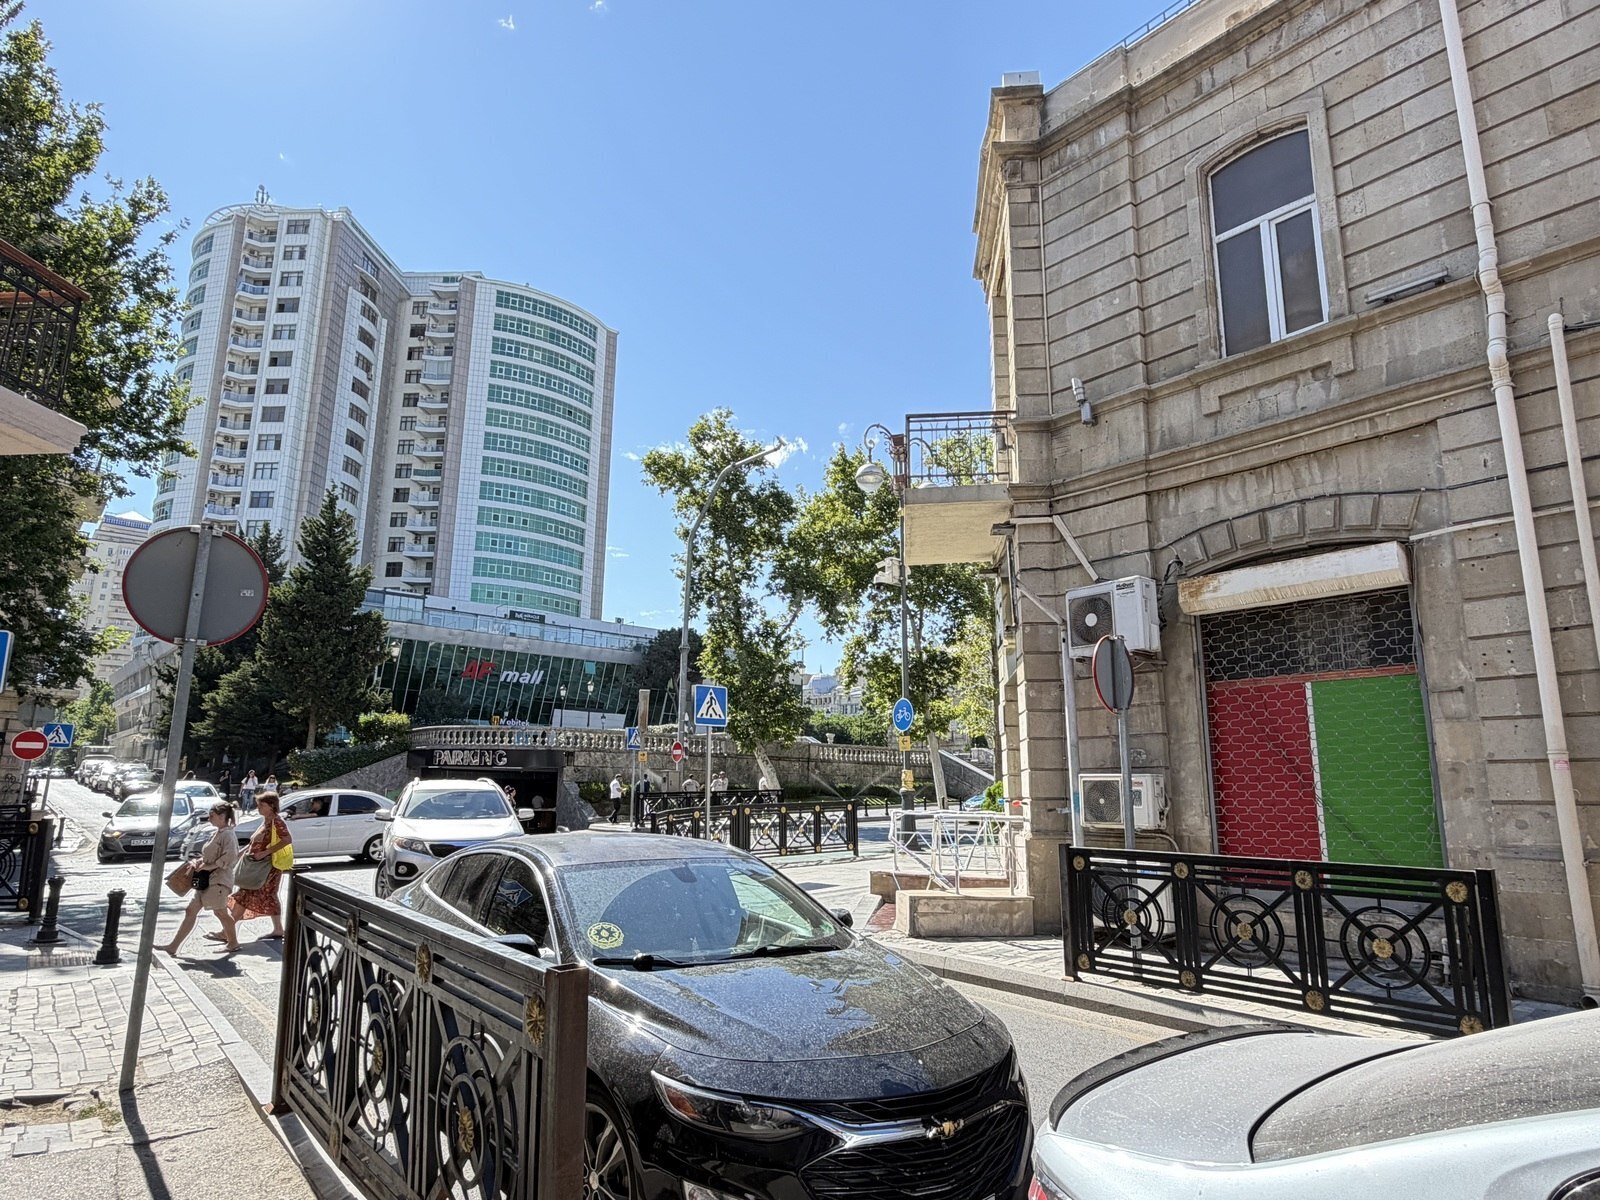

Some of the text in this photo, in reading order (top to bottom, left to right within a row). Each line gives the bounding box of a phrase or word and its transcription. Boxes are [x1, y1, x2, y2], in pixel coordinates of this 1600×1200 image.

[461, 659, 544, 684] AF mall
[433, 749, 507, 766] PARKING
